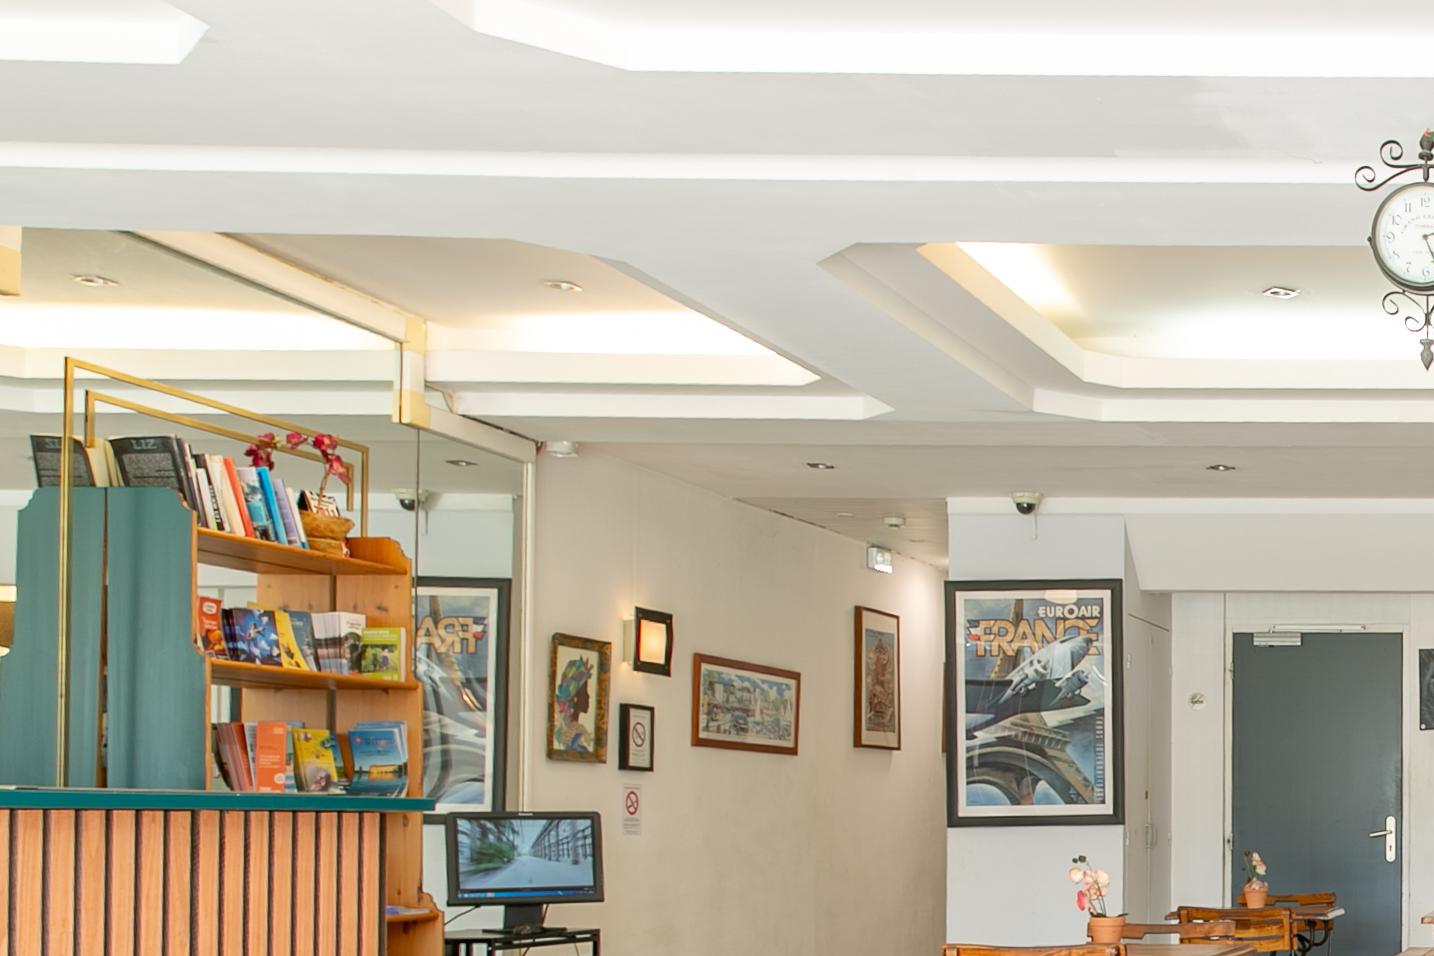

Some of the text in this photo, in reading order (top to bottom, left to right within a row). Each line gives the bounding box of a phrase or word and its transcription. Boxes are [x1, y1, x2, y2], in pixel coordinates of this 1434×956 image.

[1404, 202, 1412, 213] 11
[1420, 196, 1431, 208] 12
[1391, 214, 1402, 226] 10
[1386, 231, 1396, 243] 9
[1037, 604, 1101, 618] EUROAIR
